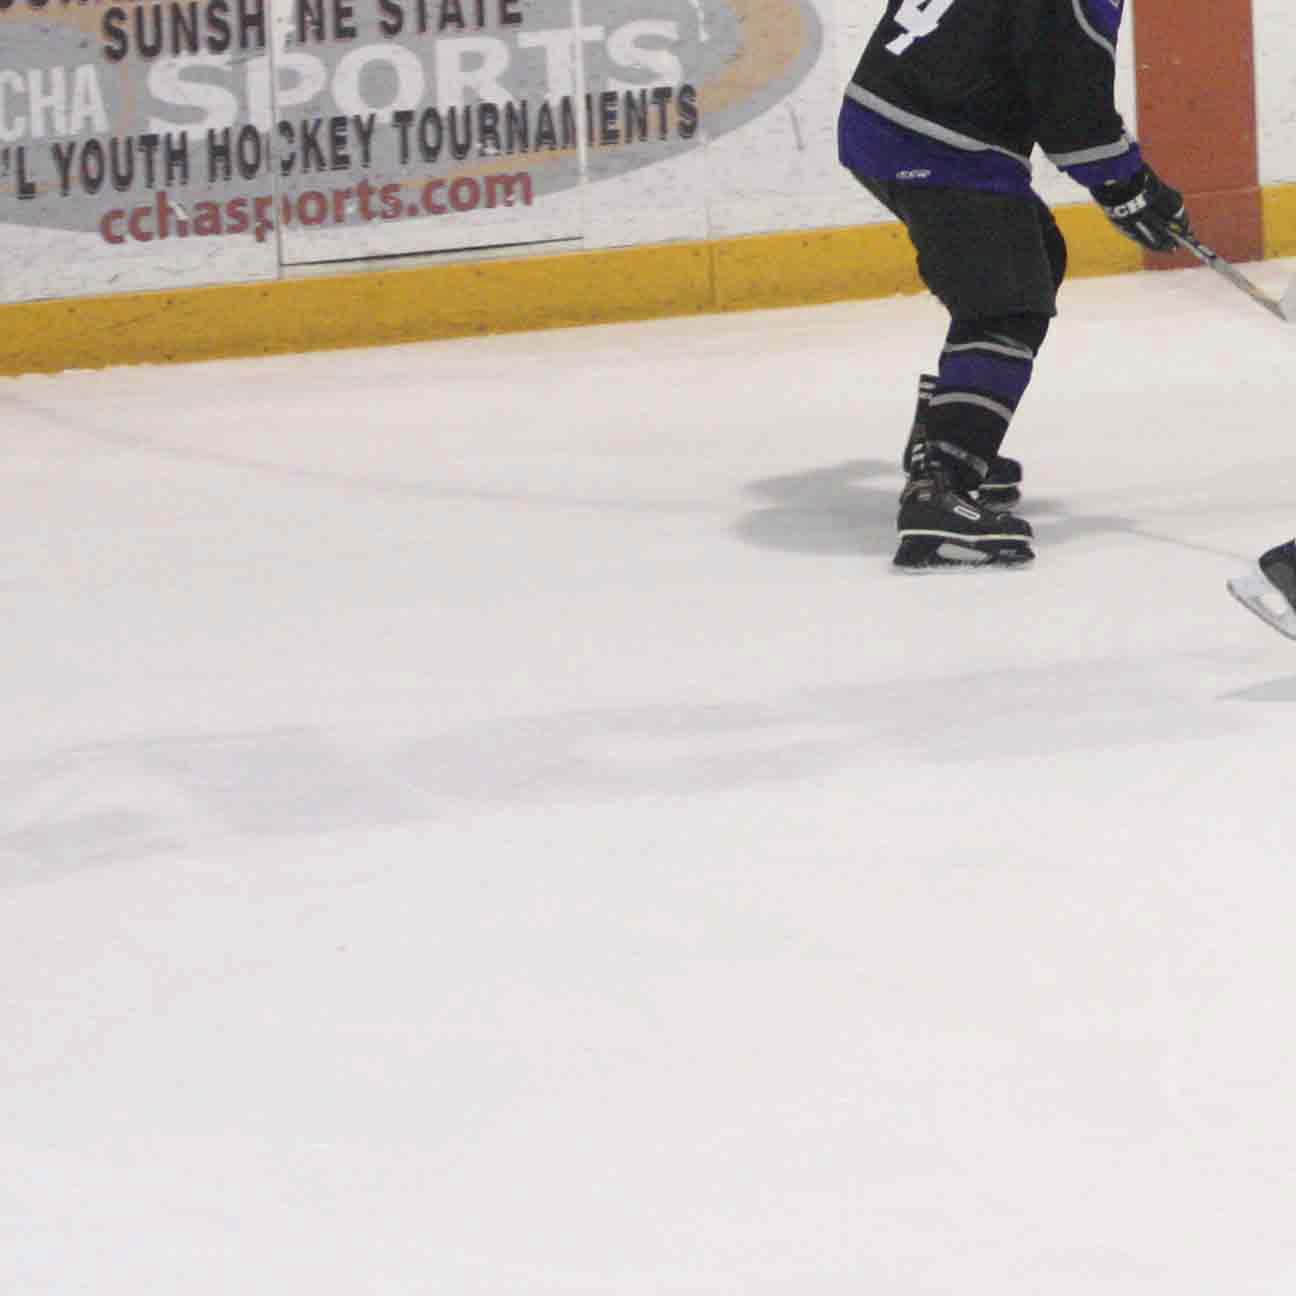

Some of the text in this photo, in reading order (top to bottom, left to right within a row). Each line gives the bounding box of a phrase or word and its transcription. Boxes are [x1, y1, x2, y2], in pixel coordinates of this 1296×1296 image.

[146, 19, 685, 141] SPORTS
[51, 131, 190, 200] YOUTH
[206, 112, 377, 184] HOCKEY
[395, 84, 699, 166] TOURNAMENTS
[101, 171, 534, 244] cchasports.com
